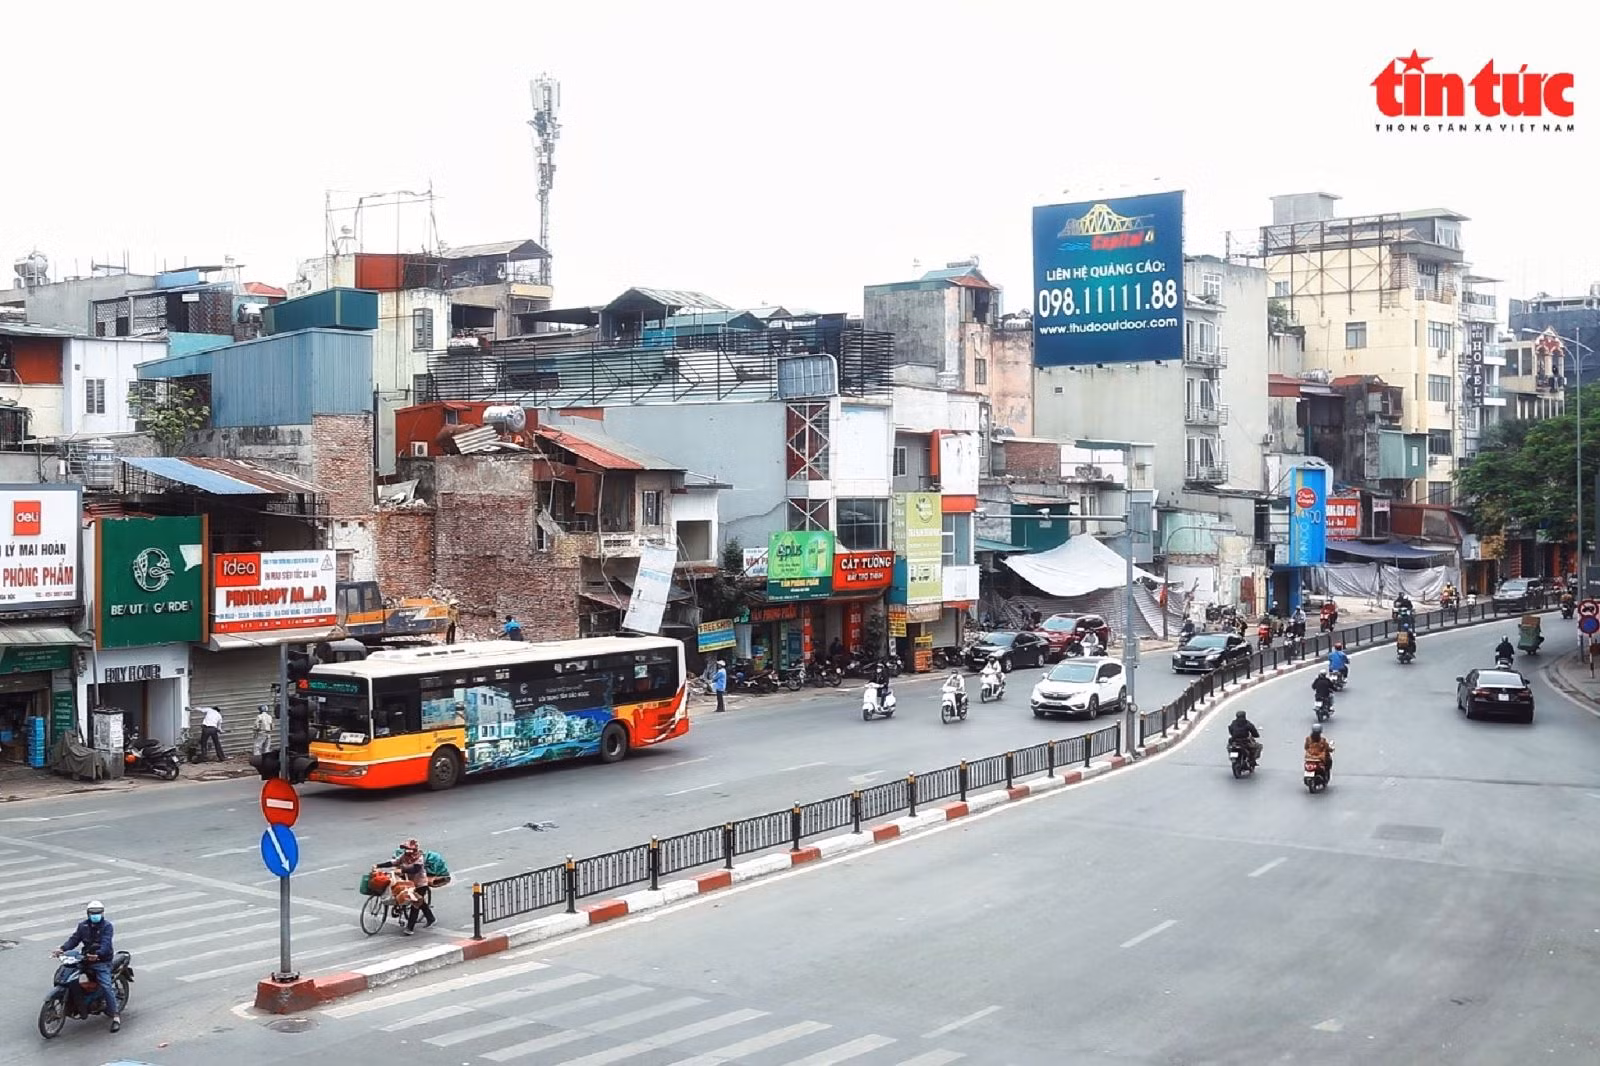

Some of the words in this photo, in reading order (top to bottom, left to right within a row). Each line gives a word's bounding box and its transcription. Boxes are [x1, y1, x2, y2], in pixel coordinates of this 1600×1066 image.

[1046, 266, 1072, 281] LIÊN
[1073, 265, 1088, 280] HỆ
[1090, 262, 1133, 277] QUẢNG
[1136, 259, 1166, 273] CÁO:
[1038, 279, 1178, 318] 098.11111.88
[1039, 317, 1178, 335] www.thudooutdoor.com
[1471, 341, 1482, 397] HOTEL
[16, 511, 40, 523] deli
[5, 541, 16, 557] LÝ
[19, 543, 38, 556] MAI
[41, 539, 67, 556] HOÀN
[840, 554, 860, 570] CÁT
[861, 552, 892, 569] TƯỜNG
[3, 563, 39, 588] PHÒNG
[42, 558, 74, 586] PHẨM
